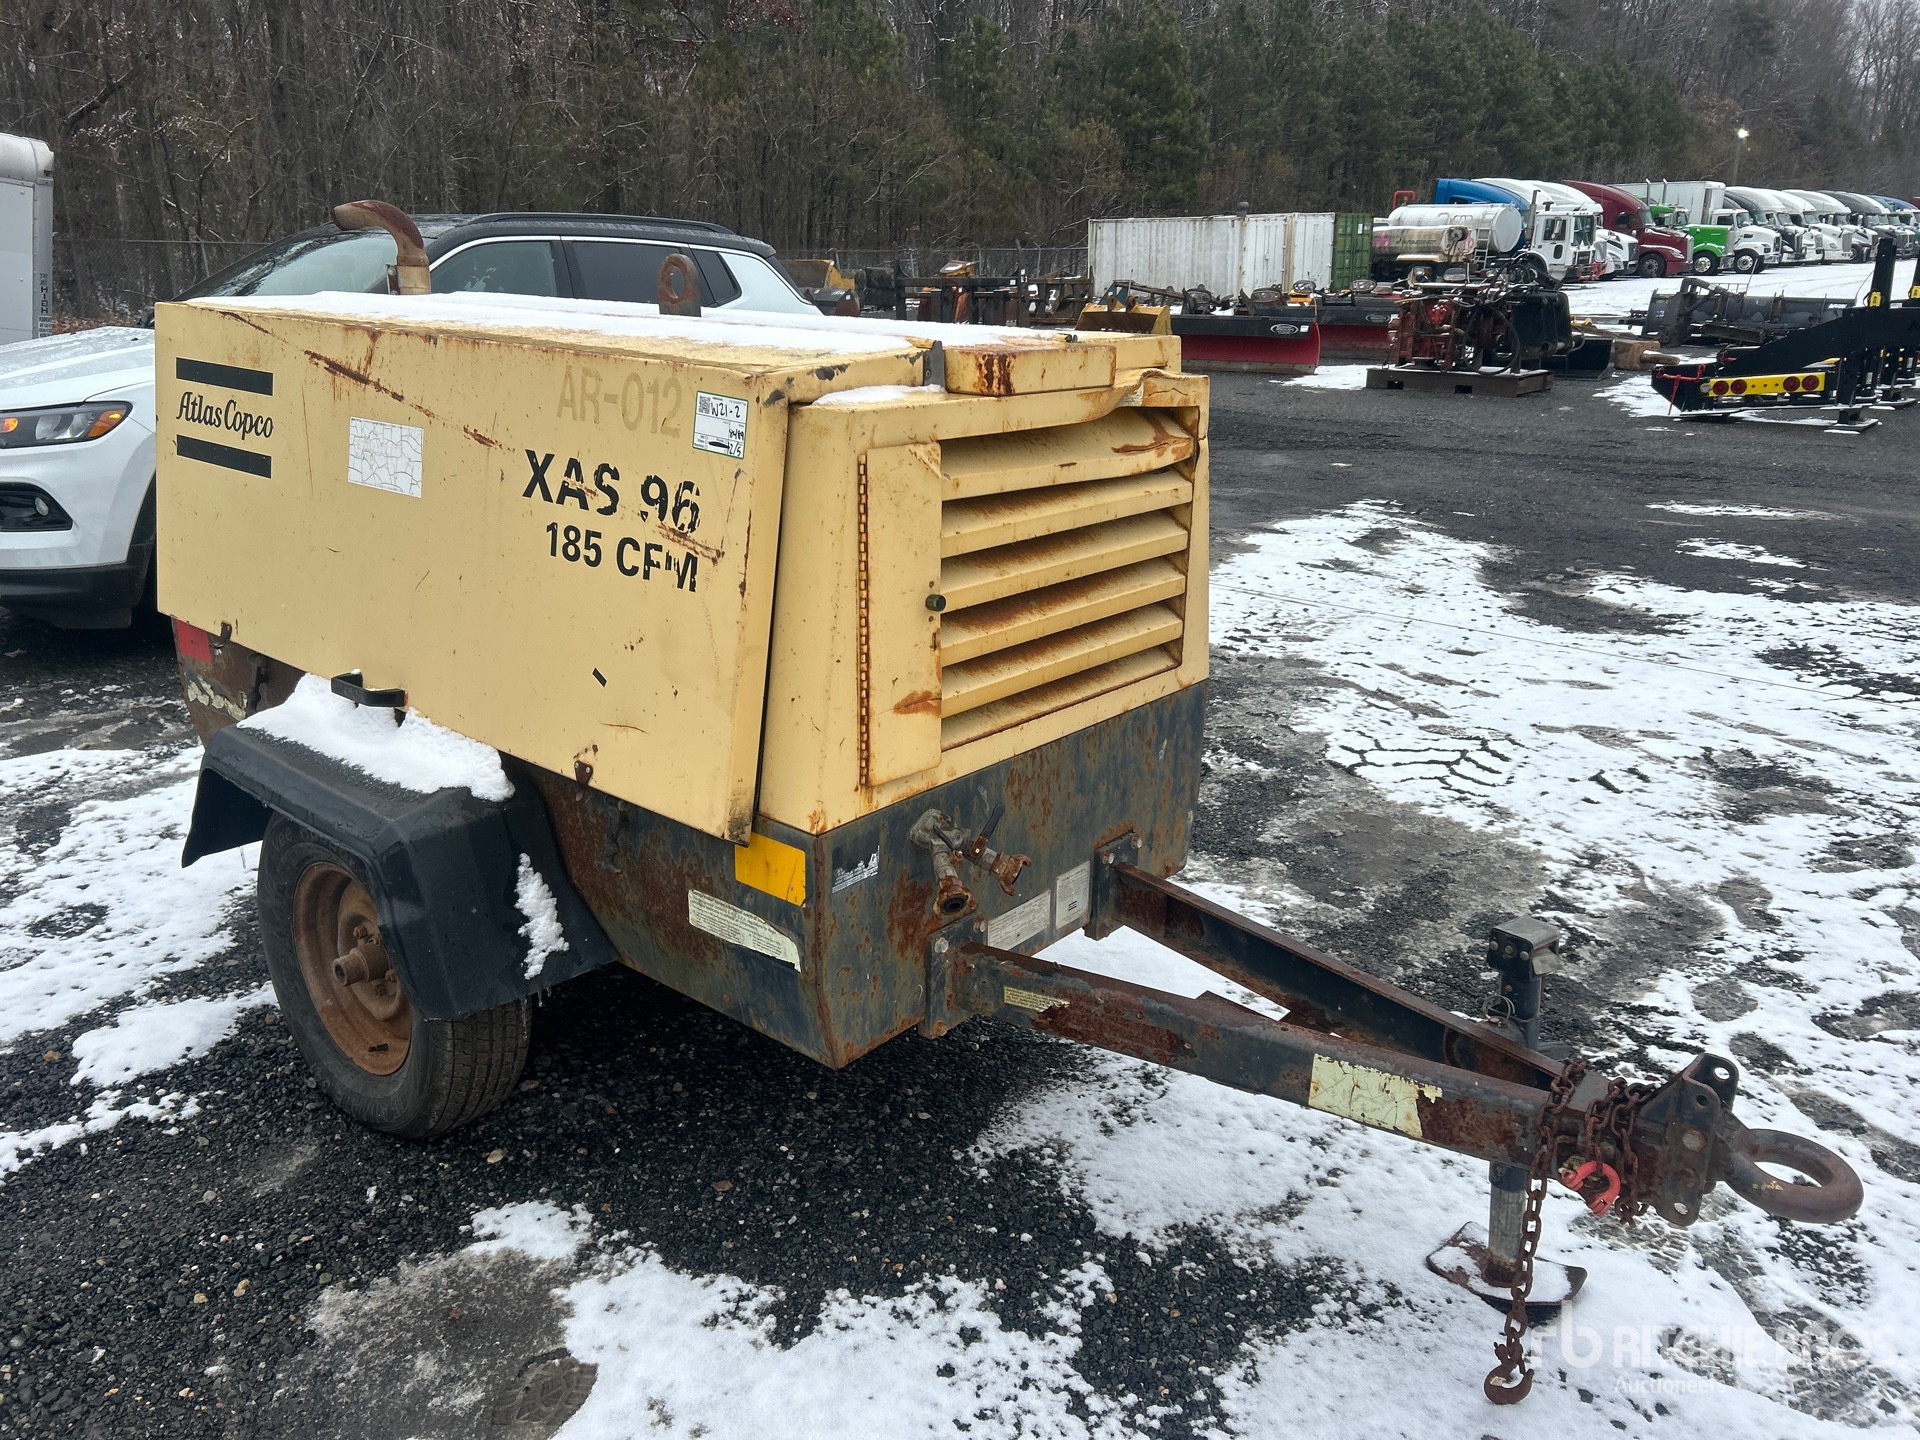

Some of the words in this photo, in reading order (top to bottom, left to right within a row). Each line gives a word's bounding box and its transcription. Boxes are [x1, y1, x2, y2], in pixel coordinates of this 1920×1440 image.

[176, 391, 223, 429] Atlas
[224, 399, 275, 440] Copco
[556, 365, 683, 438] AR-012
[522, 449, 620, 517] XAS
[640, 474, 701, 534] 96
[546, 521, 603, 568] 185
[616, 536, 699, 593] CFM
